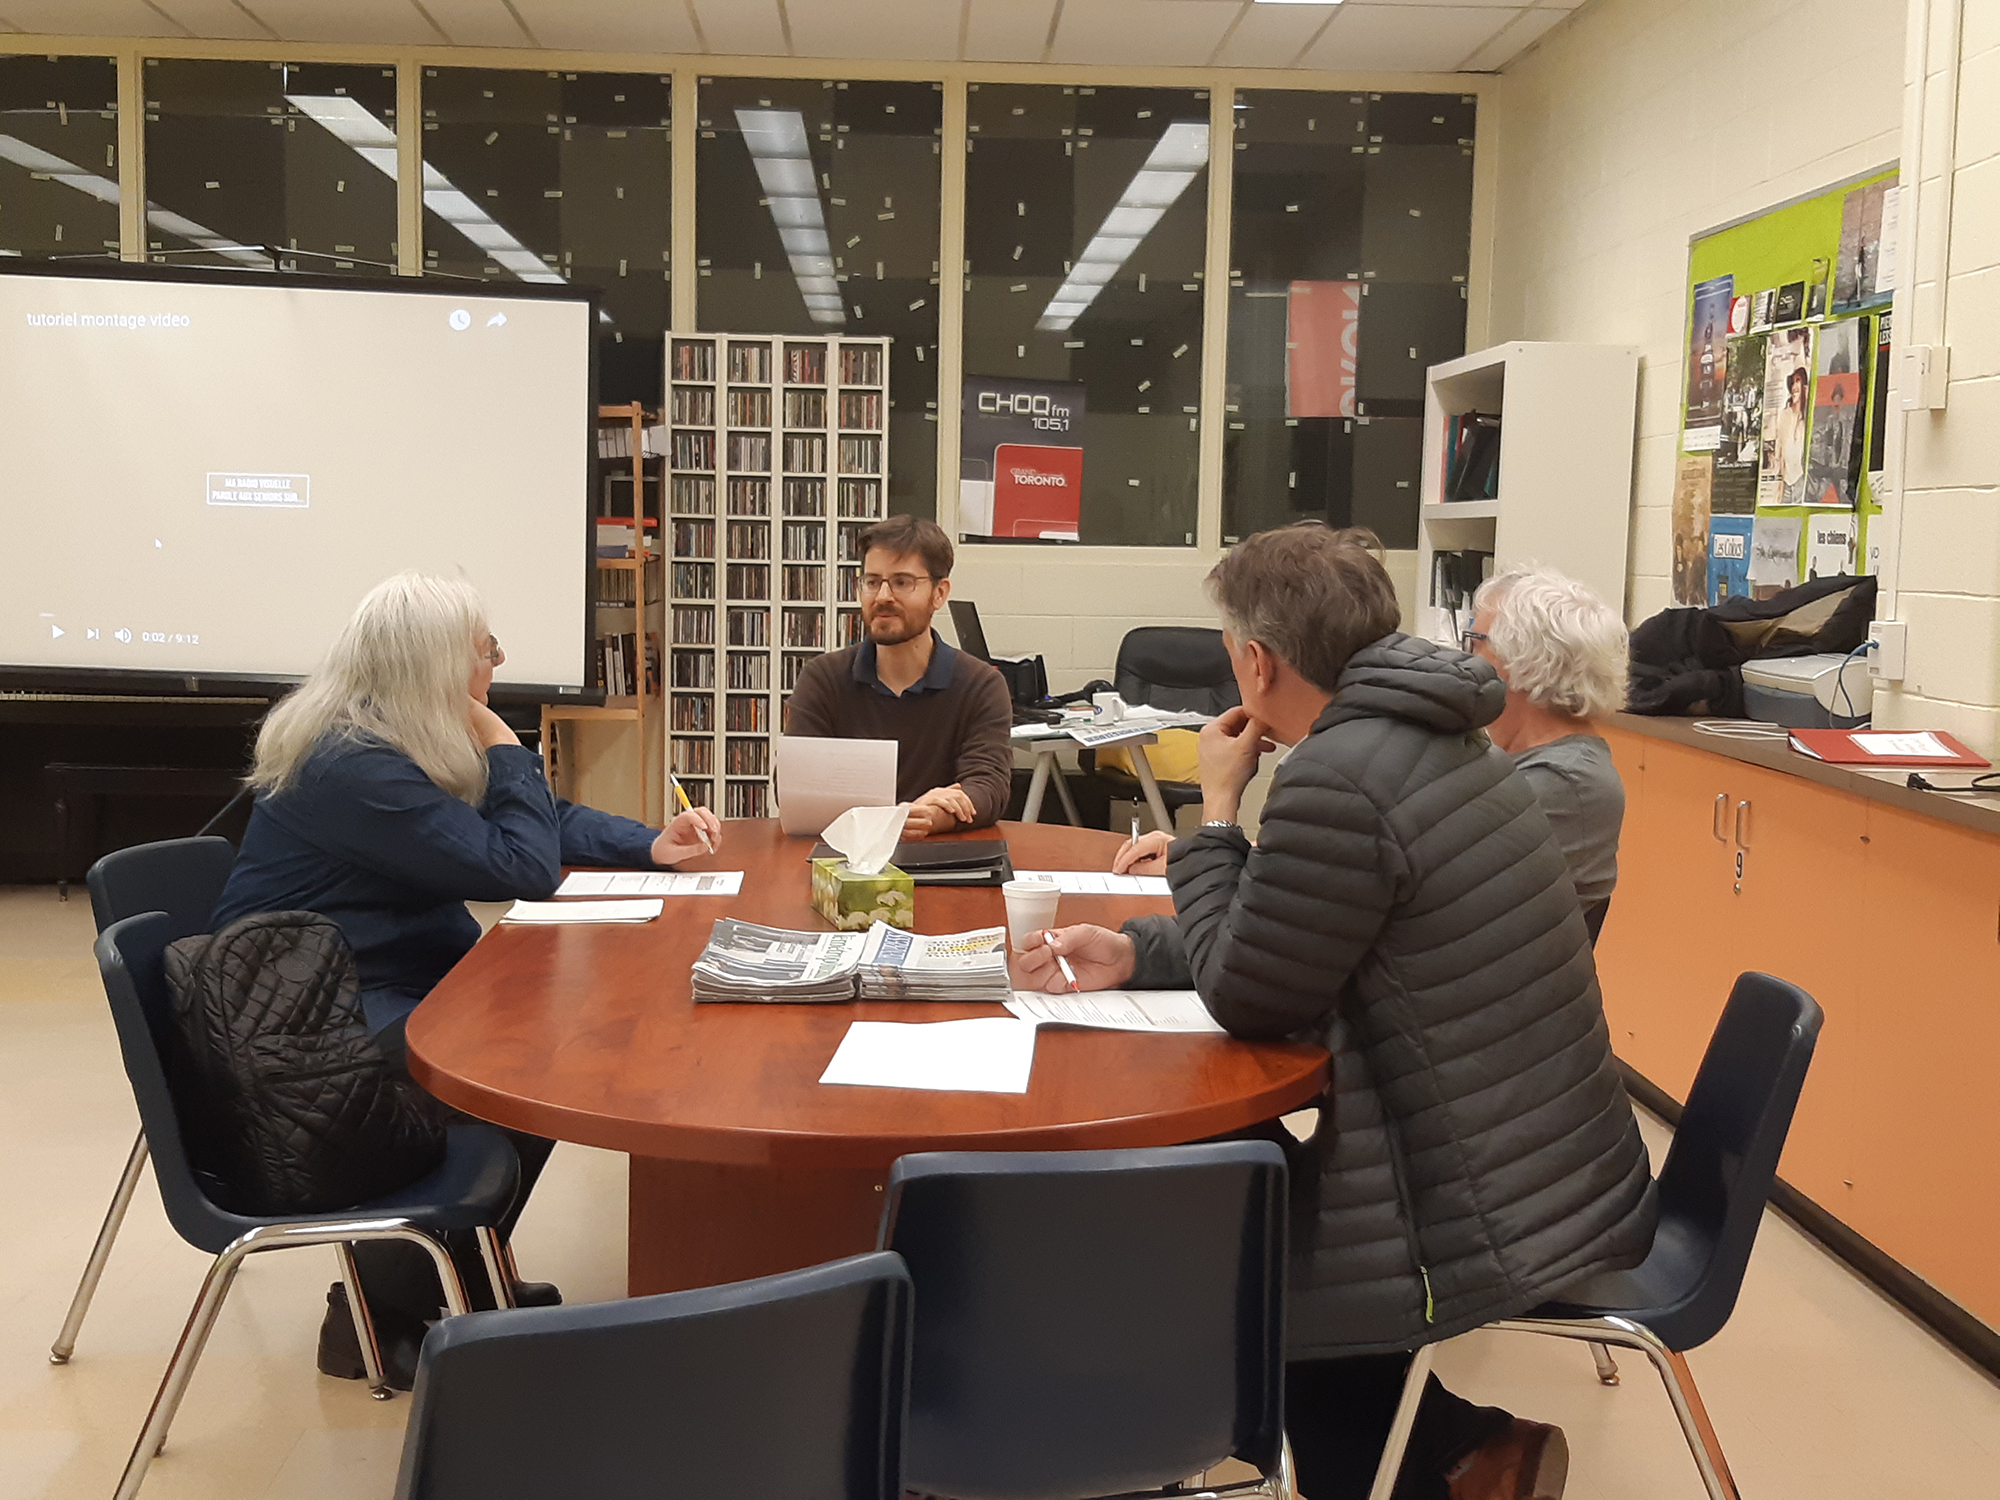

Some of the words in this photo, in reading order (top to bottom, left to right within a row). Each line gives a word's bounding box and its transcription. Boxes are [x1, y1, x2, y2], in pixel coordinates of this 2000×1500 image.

[26, 312, 78, 327] tutoriel
[81, 313, 147, 330] montage
[150, 313, 191, 328] video
[978, 392, 1050, 416] CHOQ
[1051, 404, 1070, 417] fm
[1013, 474, 1066, 487] TORONTO
[1736, 851, 1743, 879] 9
